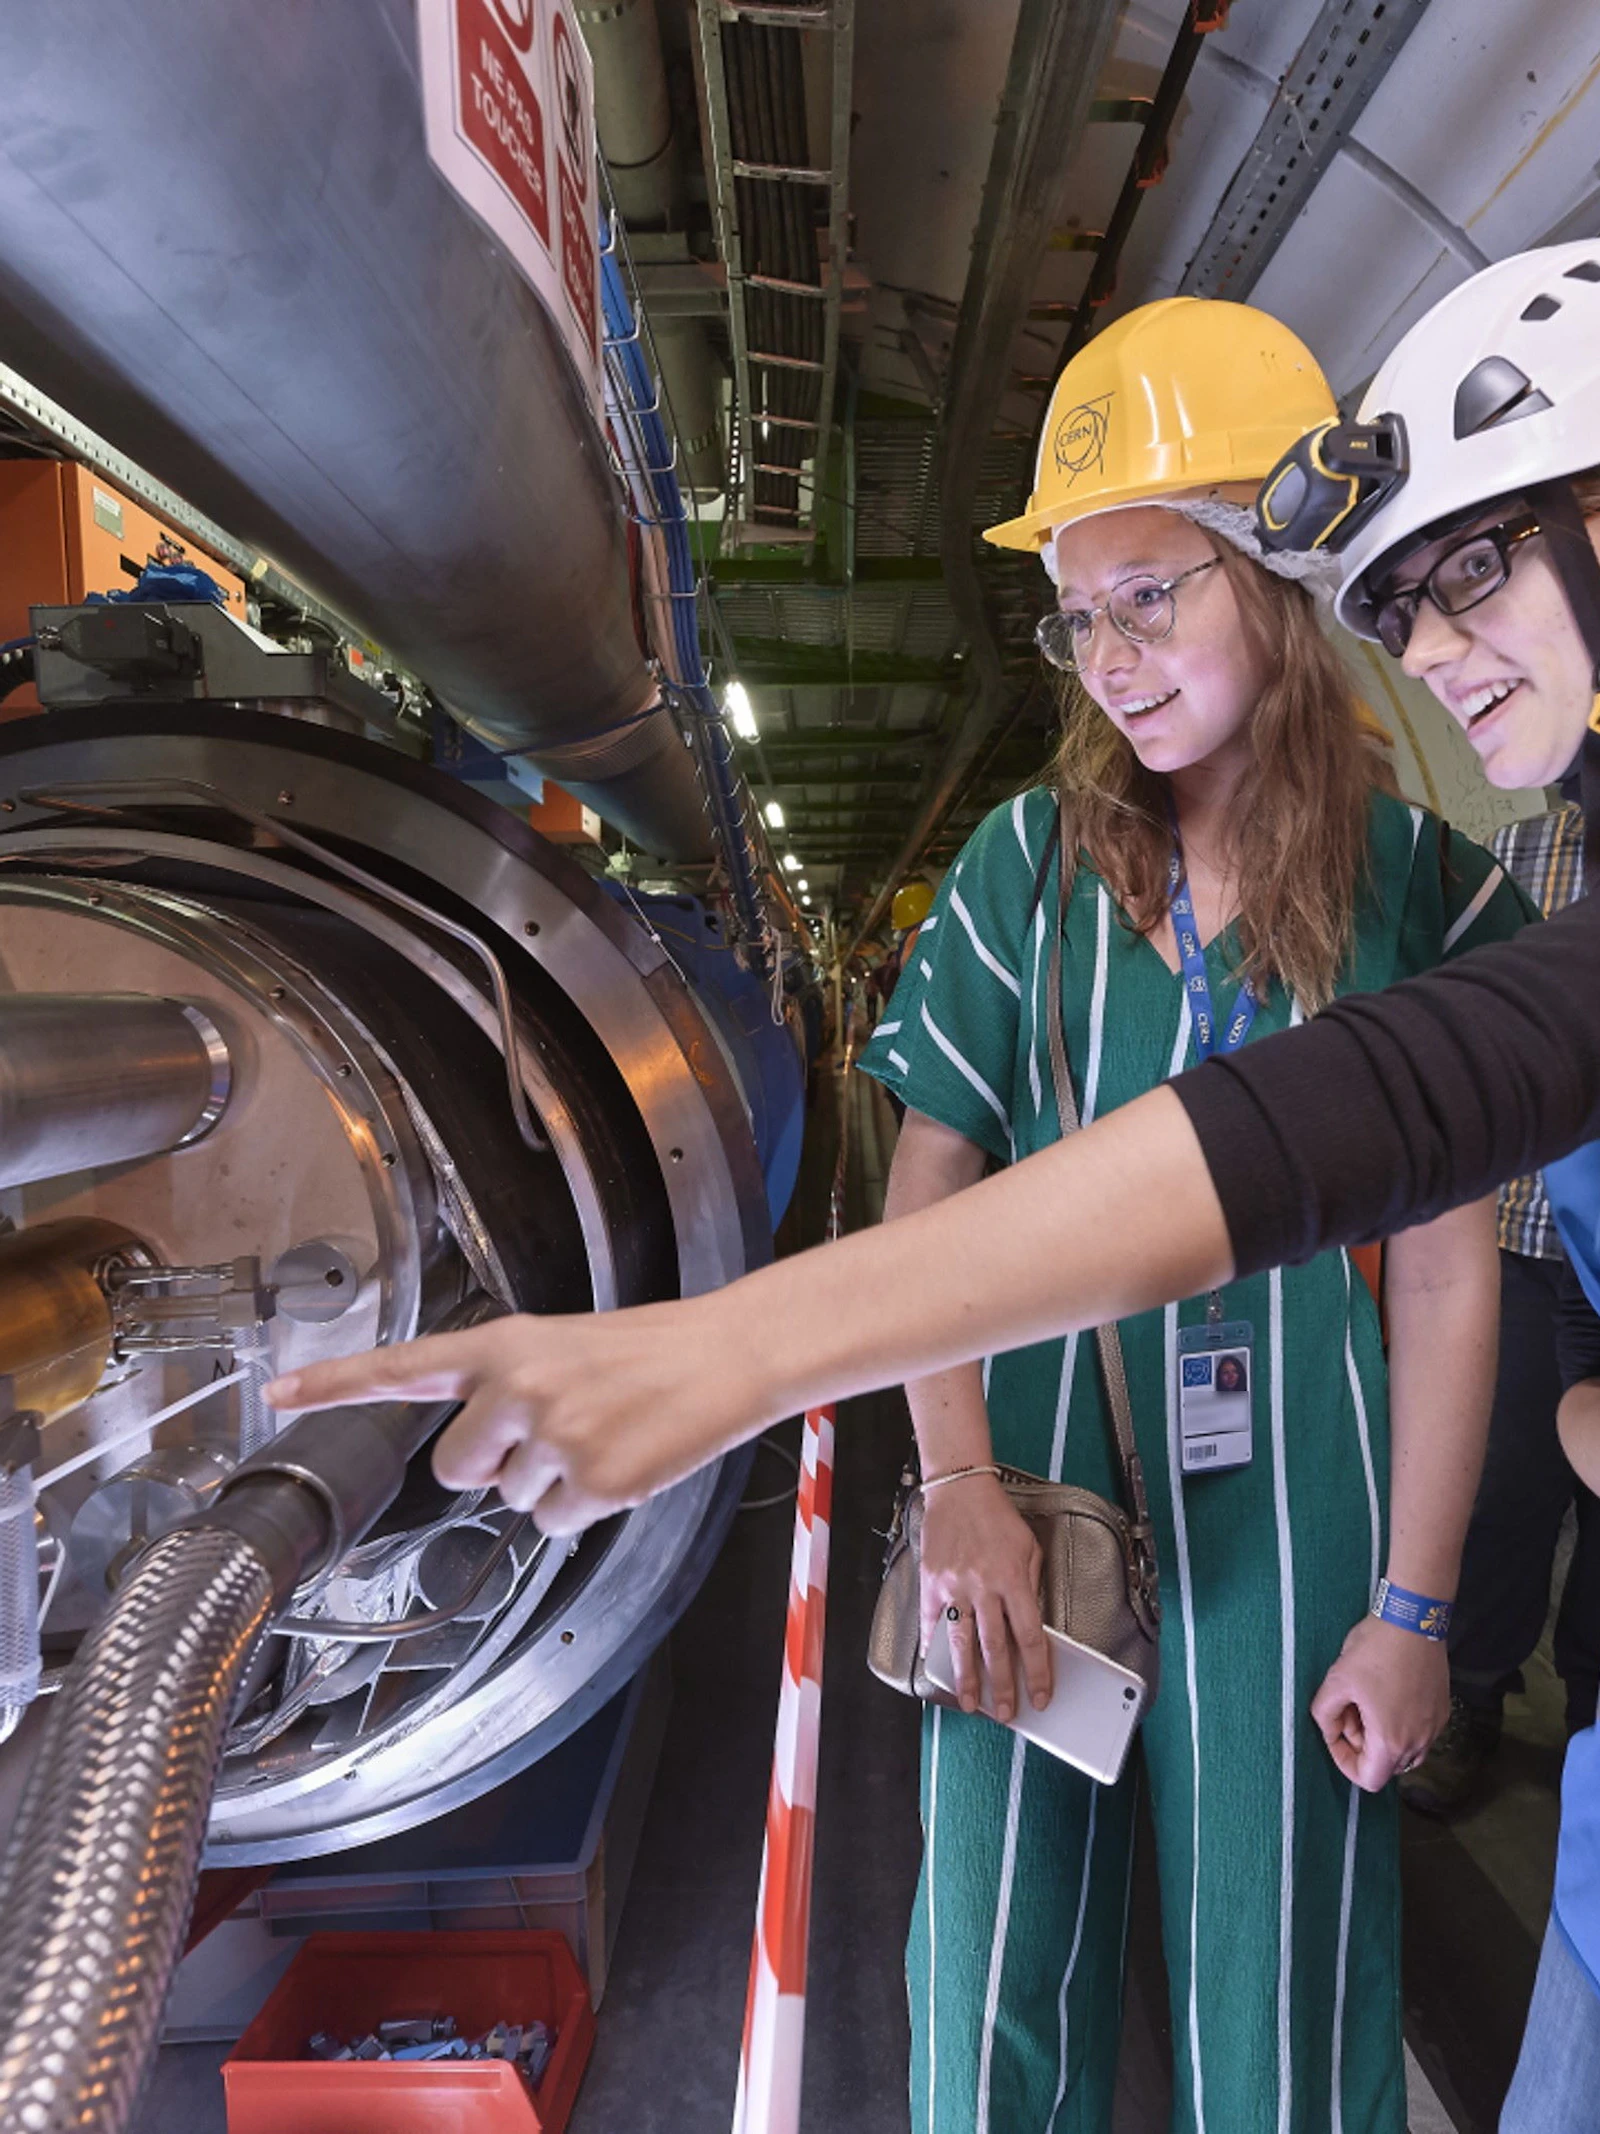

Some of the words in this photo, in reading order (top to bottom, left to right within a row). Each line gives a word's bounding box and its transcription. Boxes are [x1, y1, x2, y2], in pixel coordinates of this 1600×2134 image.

[480, 37, 505, 97] NE
[506, 79, 534, 146] PAS
[470, 72, 543, 206] TOUCHER
[1060, 423, 1092, 447] CERN
[1198, 1012, 1210, 1044] CERN
[1228, 1013, 1247, 1044] CERN
